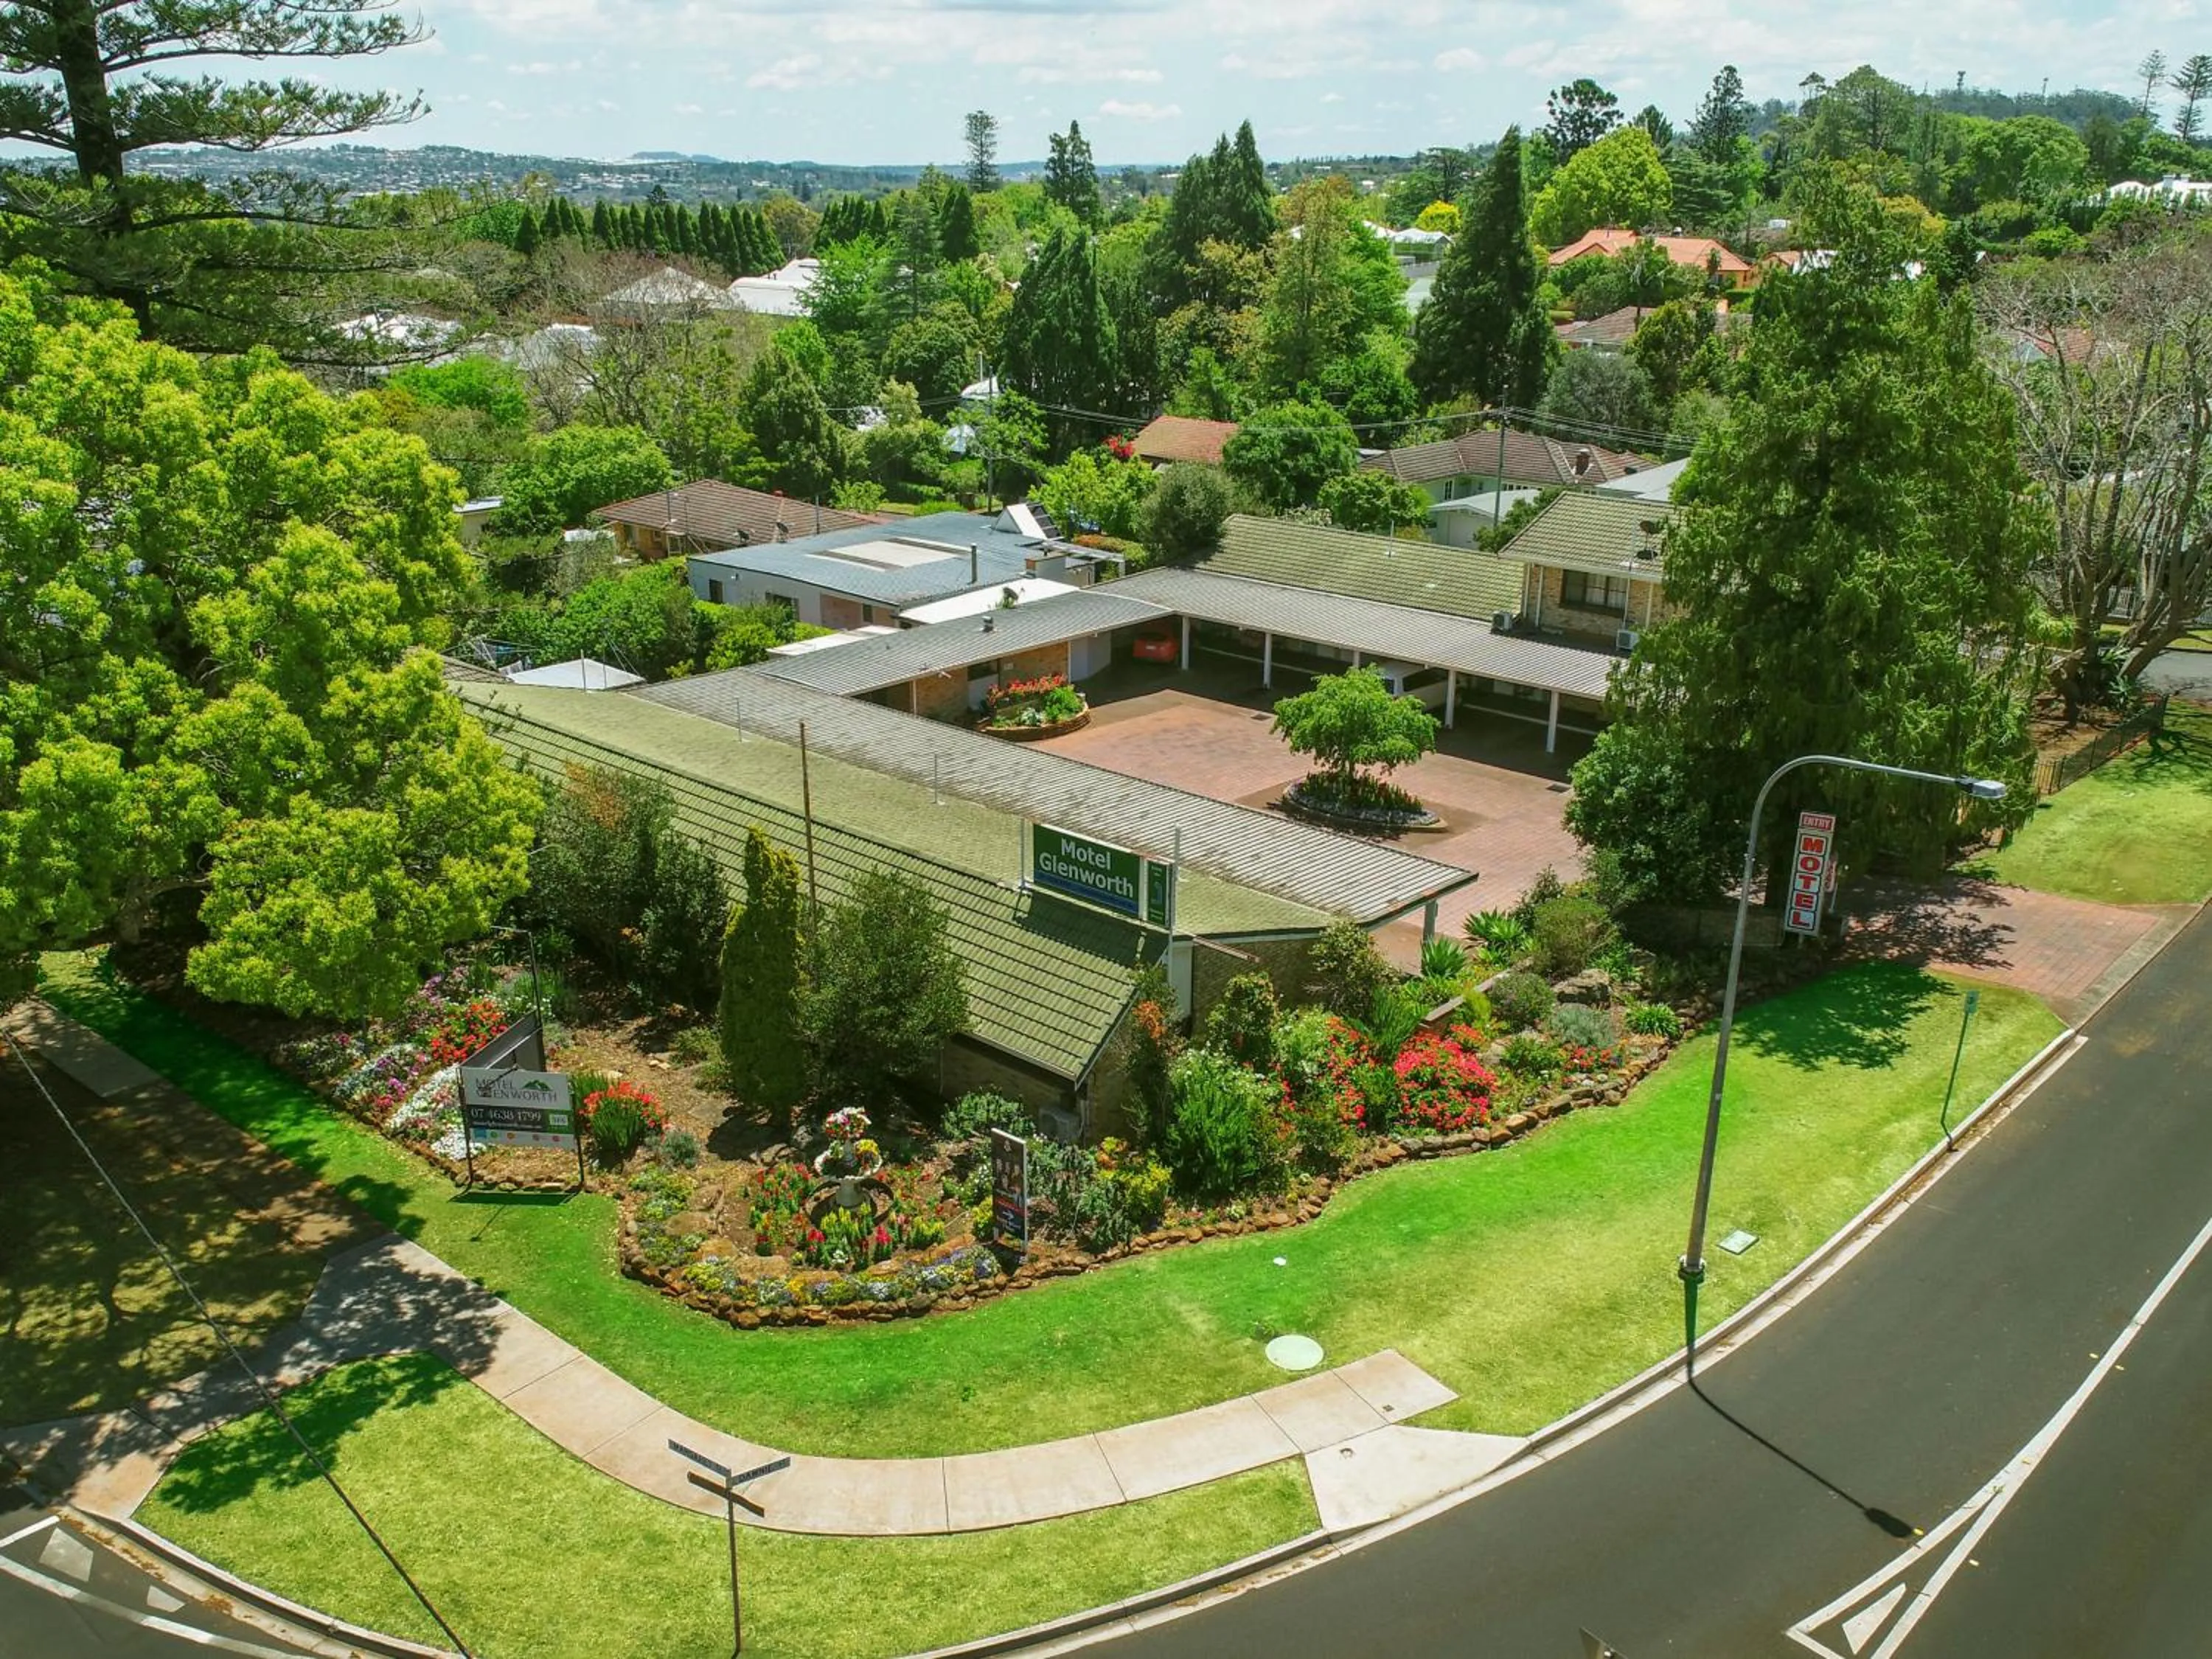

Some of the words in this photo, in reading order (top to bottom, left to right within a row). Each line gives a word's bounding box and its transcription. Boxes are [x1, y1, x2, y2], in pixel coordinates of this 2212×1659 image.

[1804, 816, 1831, 829] ENTRY
[1061, 838, 1111, 870] Motel
[1039, 852, 1134, 898] Glenworth
[1792, 837, 1824, 927] MOTEL
[476, 1089, 557, 1102] ENWORTH
